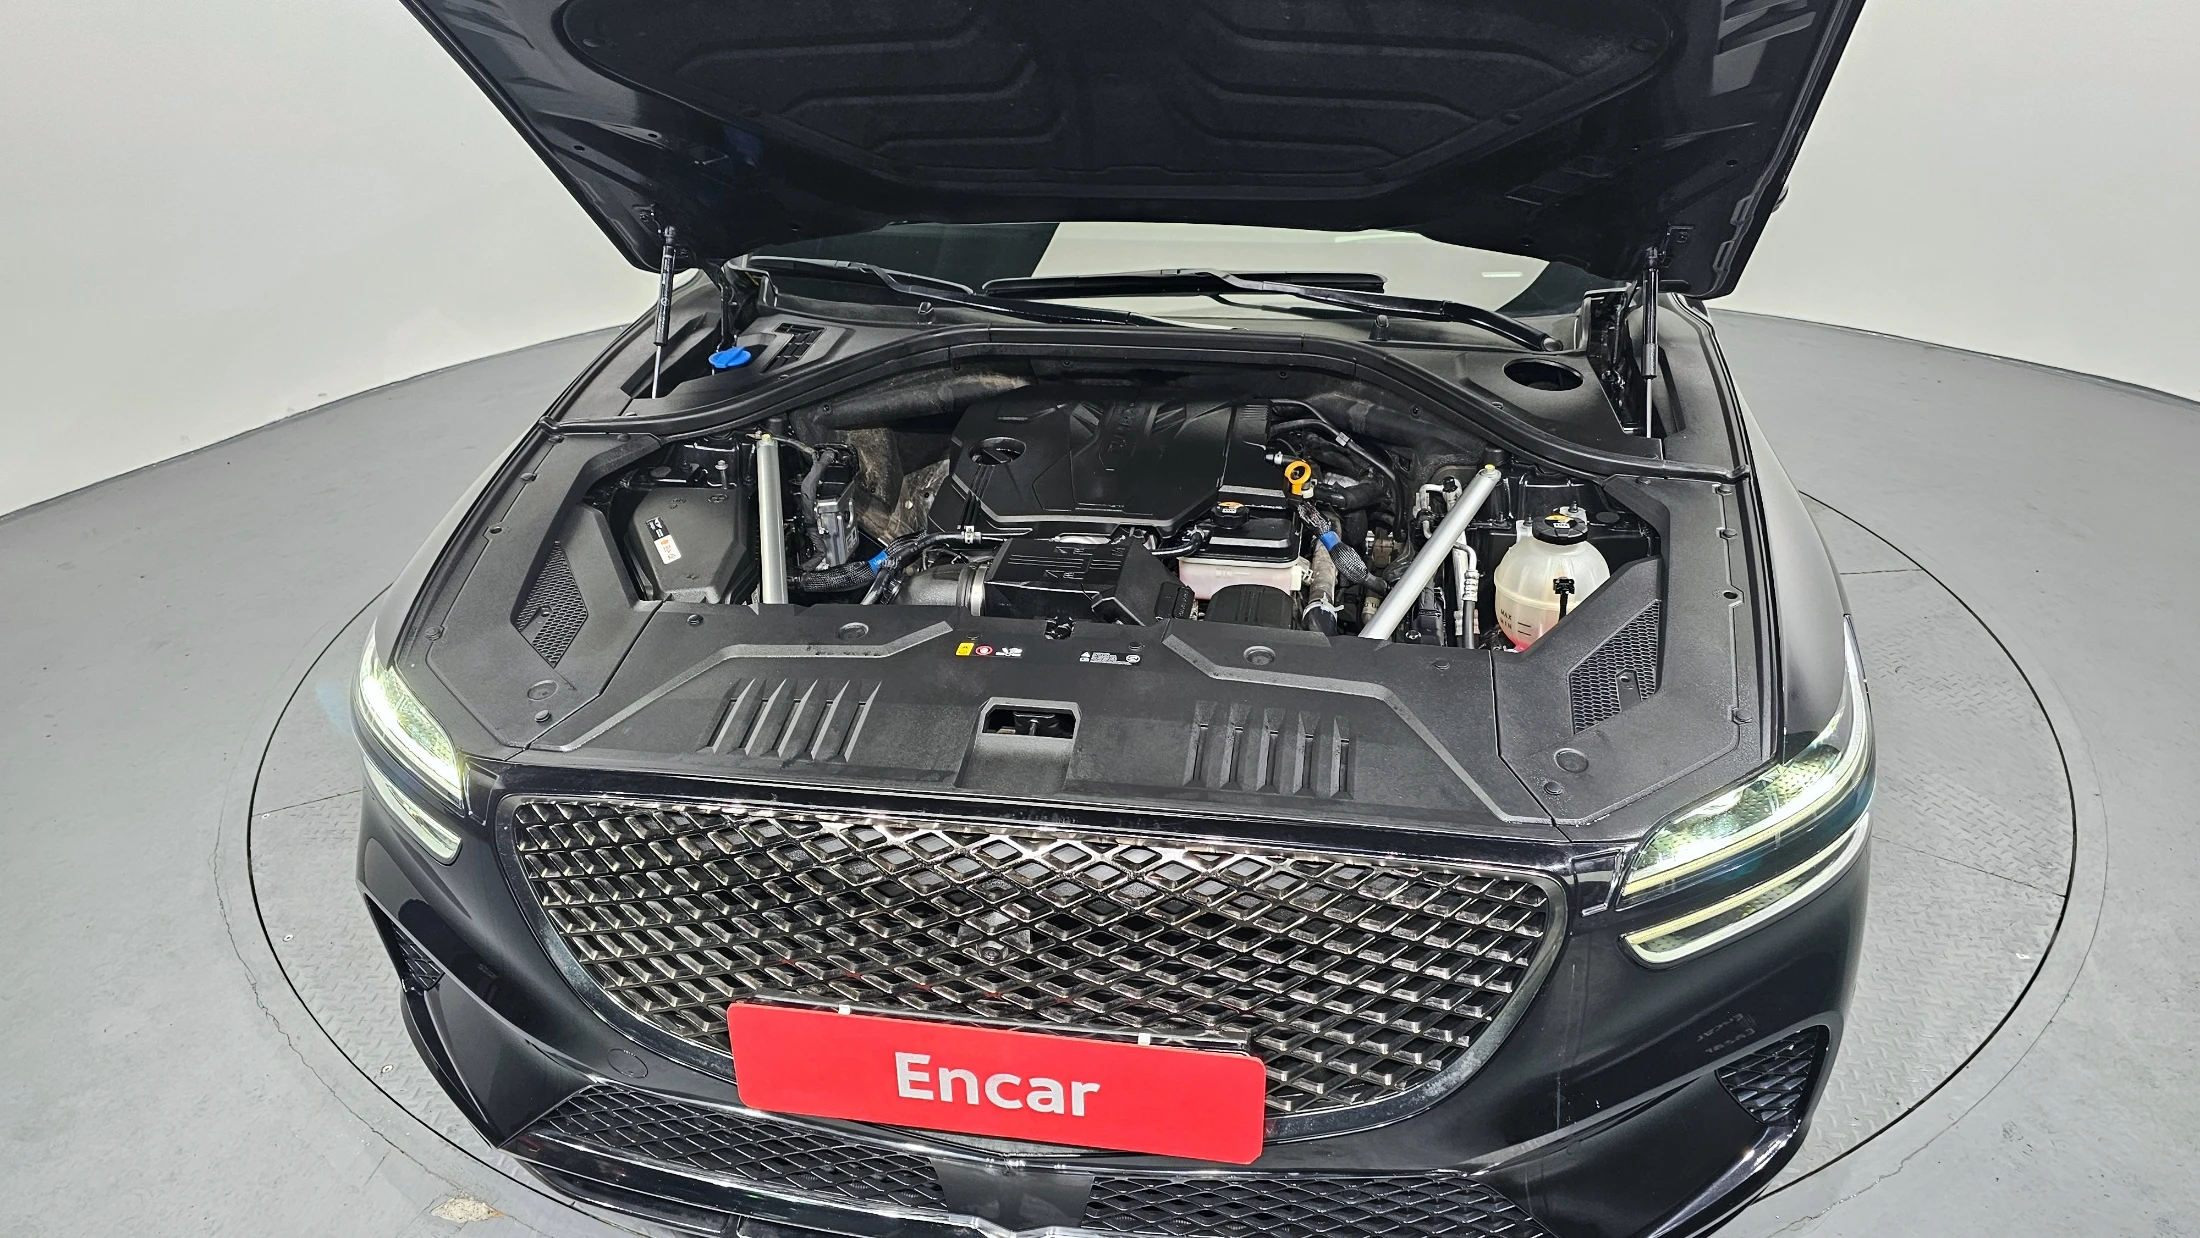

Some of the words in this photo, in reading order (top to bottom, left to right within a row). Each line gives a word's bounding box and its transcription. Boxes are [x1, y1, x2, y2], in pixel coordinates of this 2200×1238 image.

[1500, 608, 1512, 621] MAX
[1500, 617, 1512, 629] MIN
[894, 1051, 1101, 1117] Encar
